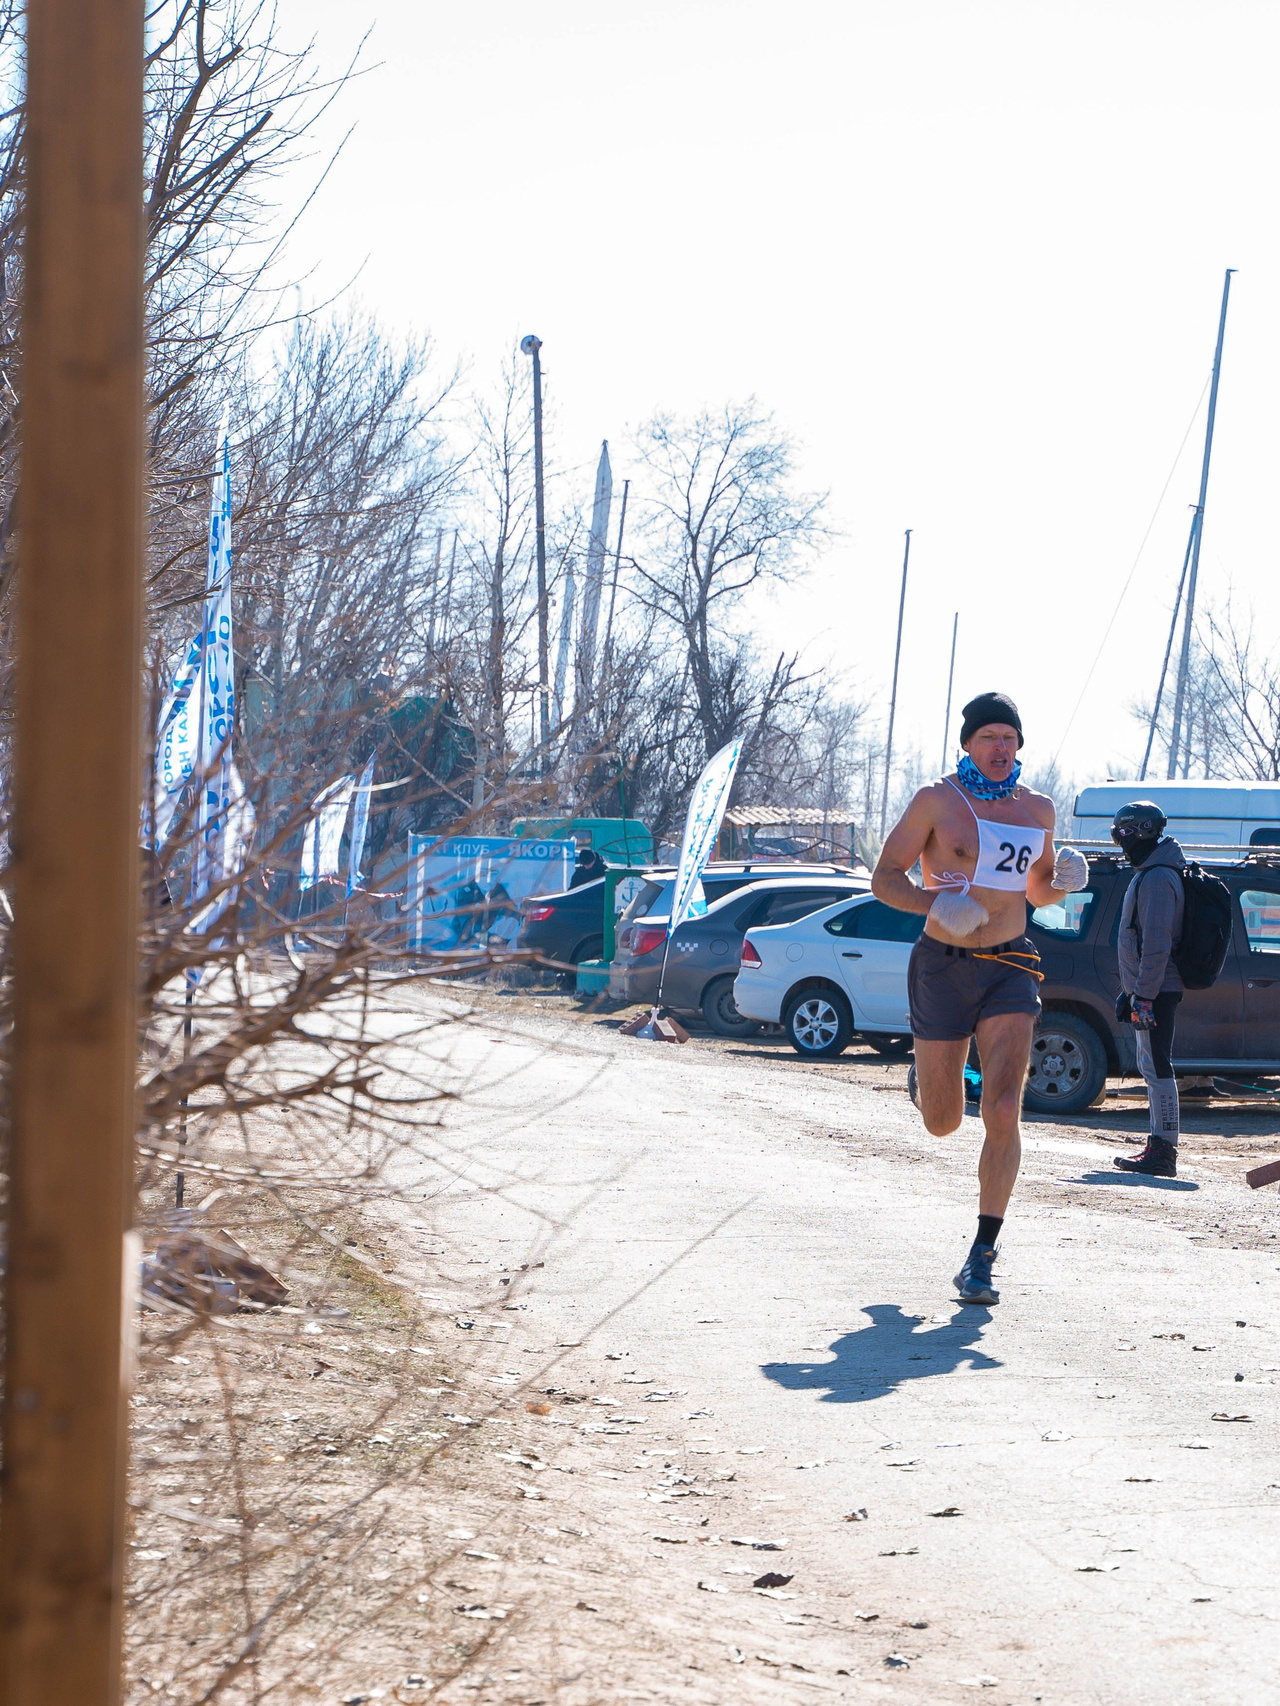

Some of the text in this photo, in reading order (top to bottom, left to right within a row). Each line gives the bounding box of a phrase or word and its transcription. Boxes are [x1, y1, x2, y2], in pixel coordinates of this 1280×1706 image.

[178, 701, 189, 744] КАЖ
[164, 725, 178, 795] ГОРОД
[453, 844, 490, 855] КЛУБ
[508, 844, 575, 860] ЯКОРЬ
[995, 841, 1033, 875] 26
